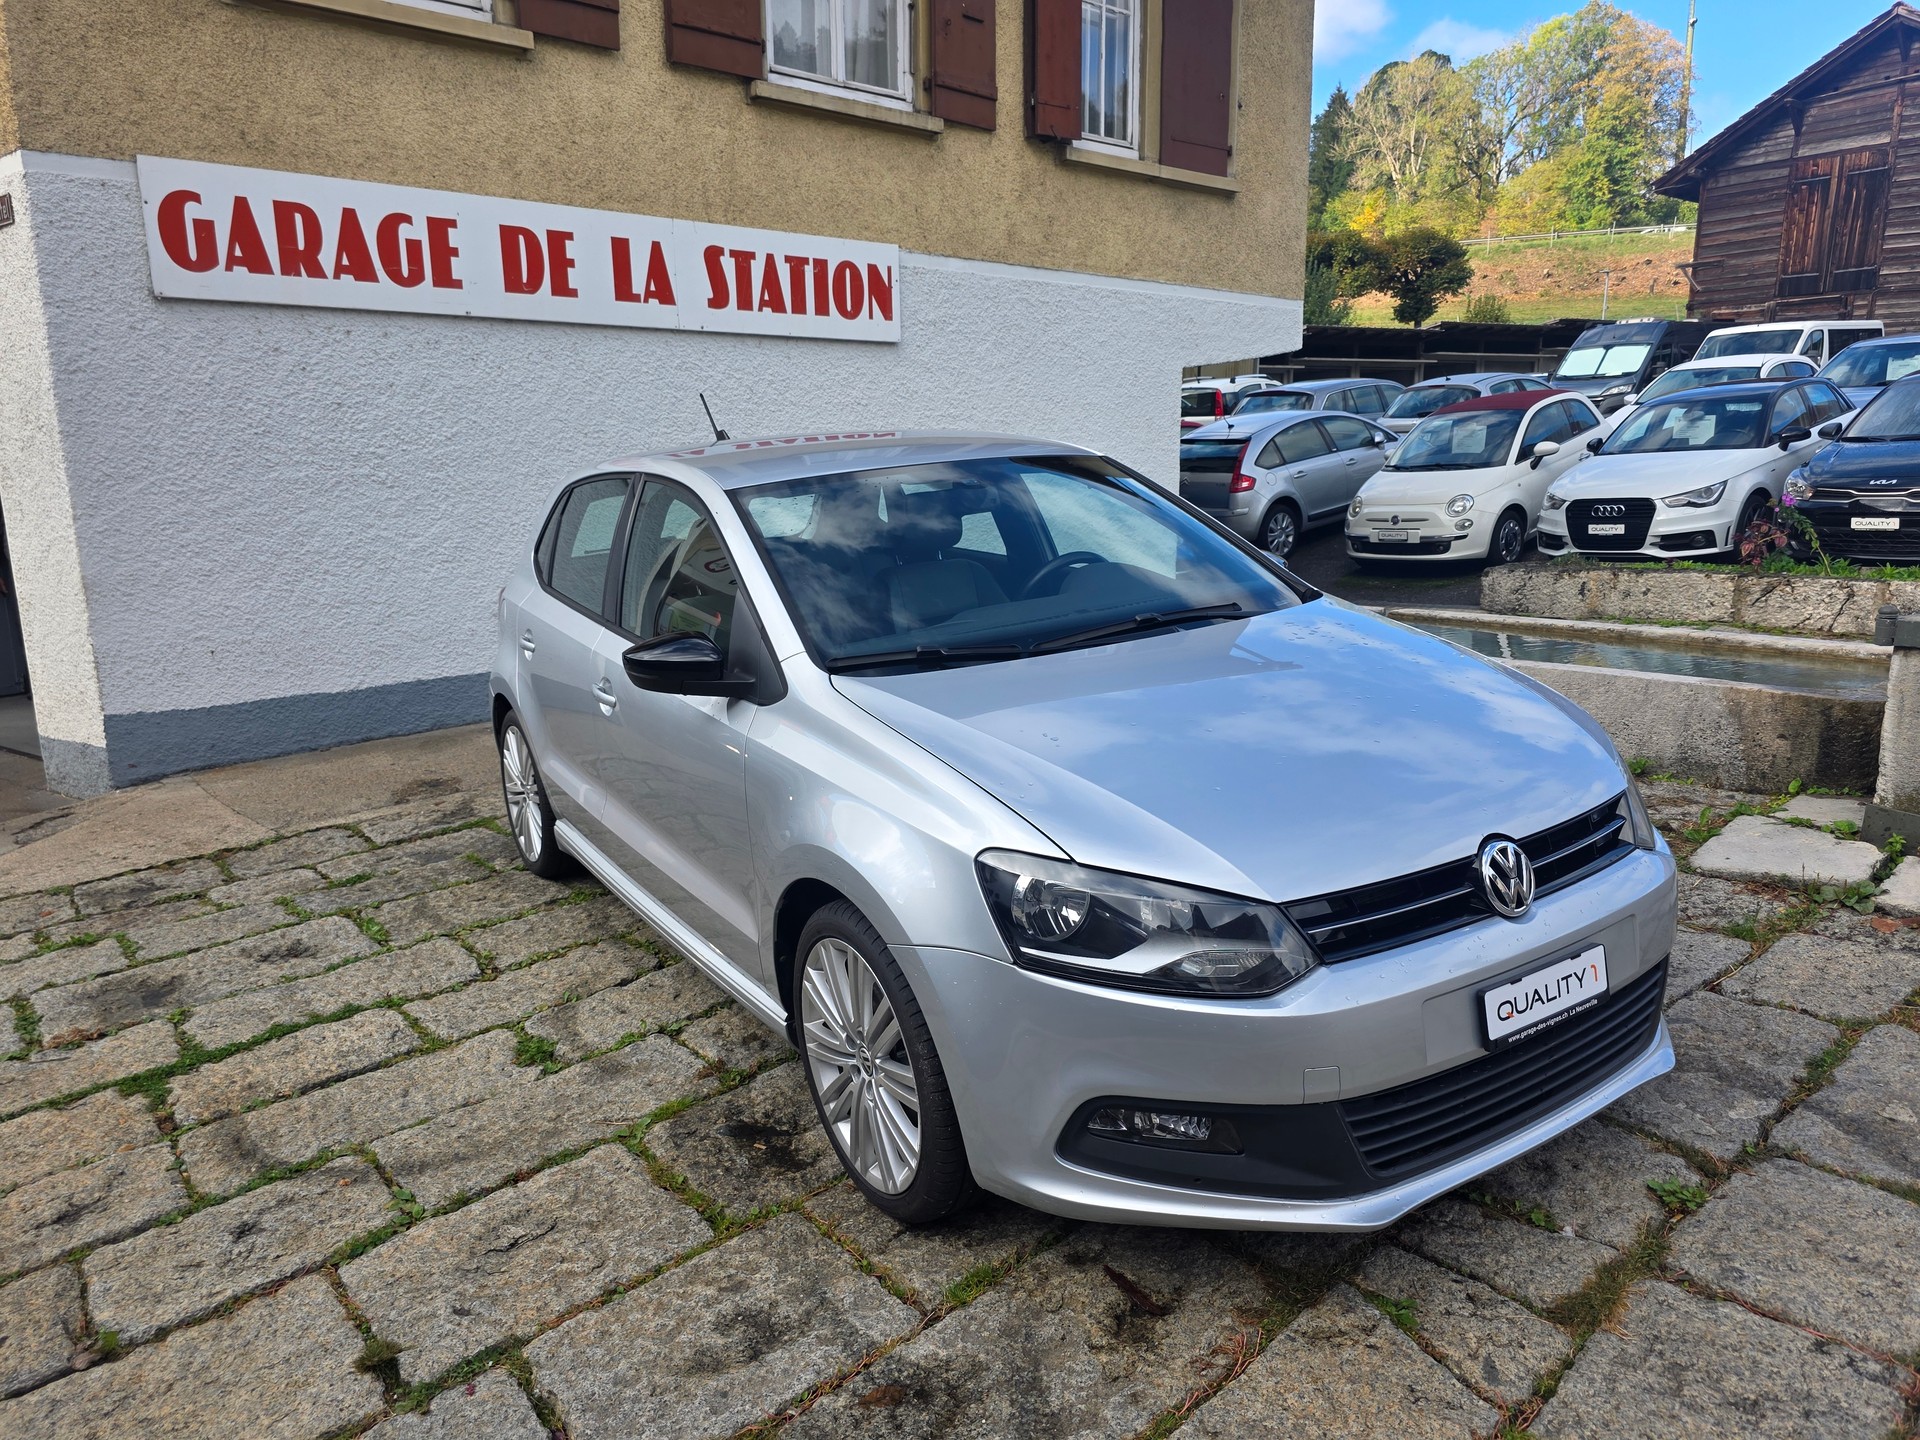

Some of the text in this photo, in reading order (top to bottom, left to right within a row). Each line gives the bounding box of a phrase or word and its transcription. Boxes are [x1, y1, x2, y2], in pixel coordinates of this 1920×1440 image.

[158, 190, 893, 322] GARAGE DE LA STATION
[1497, 967, 1587, 1022] QUALITY
